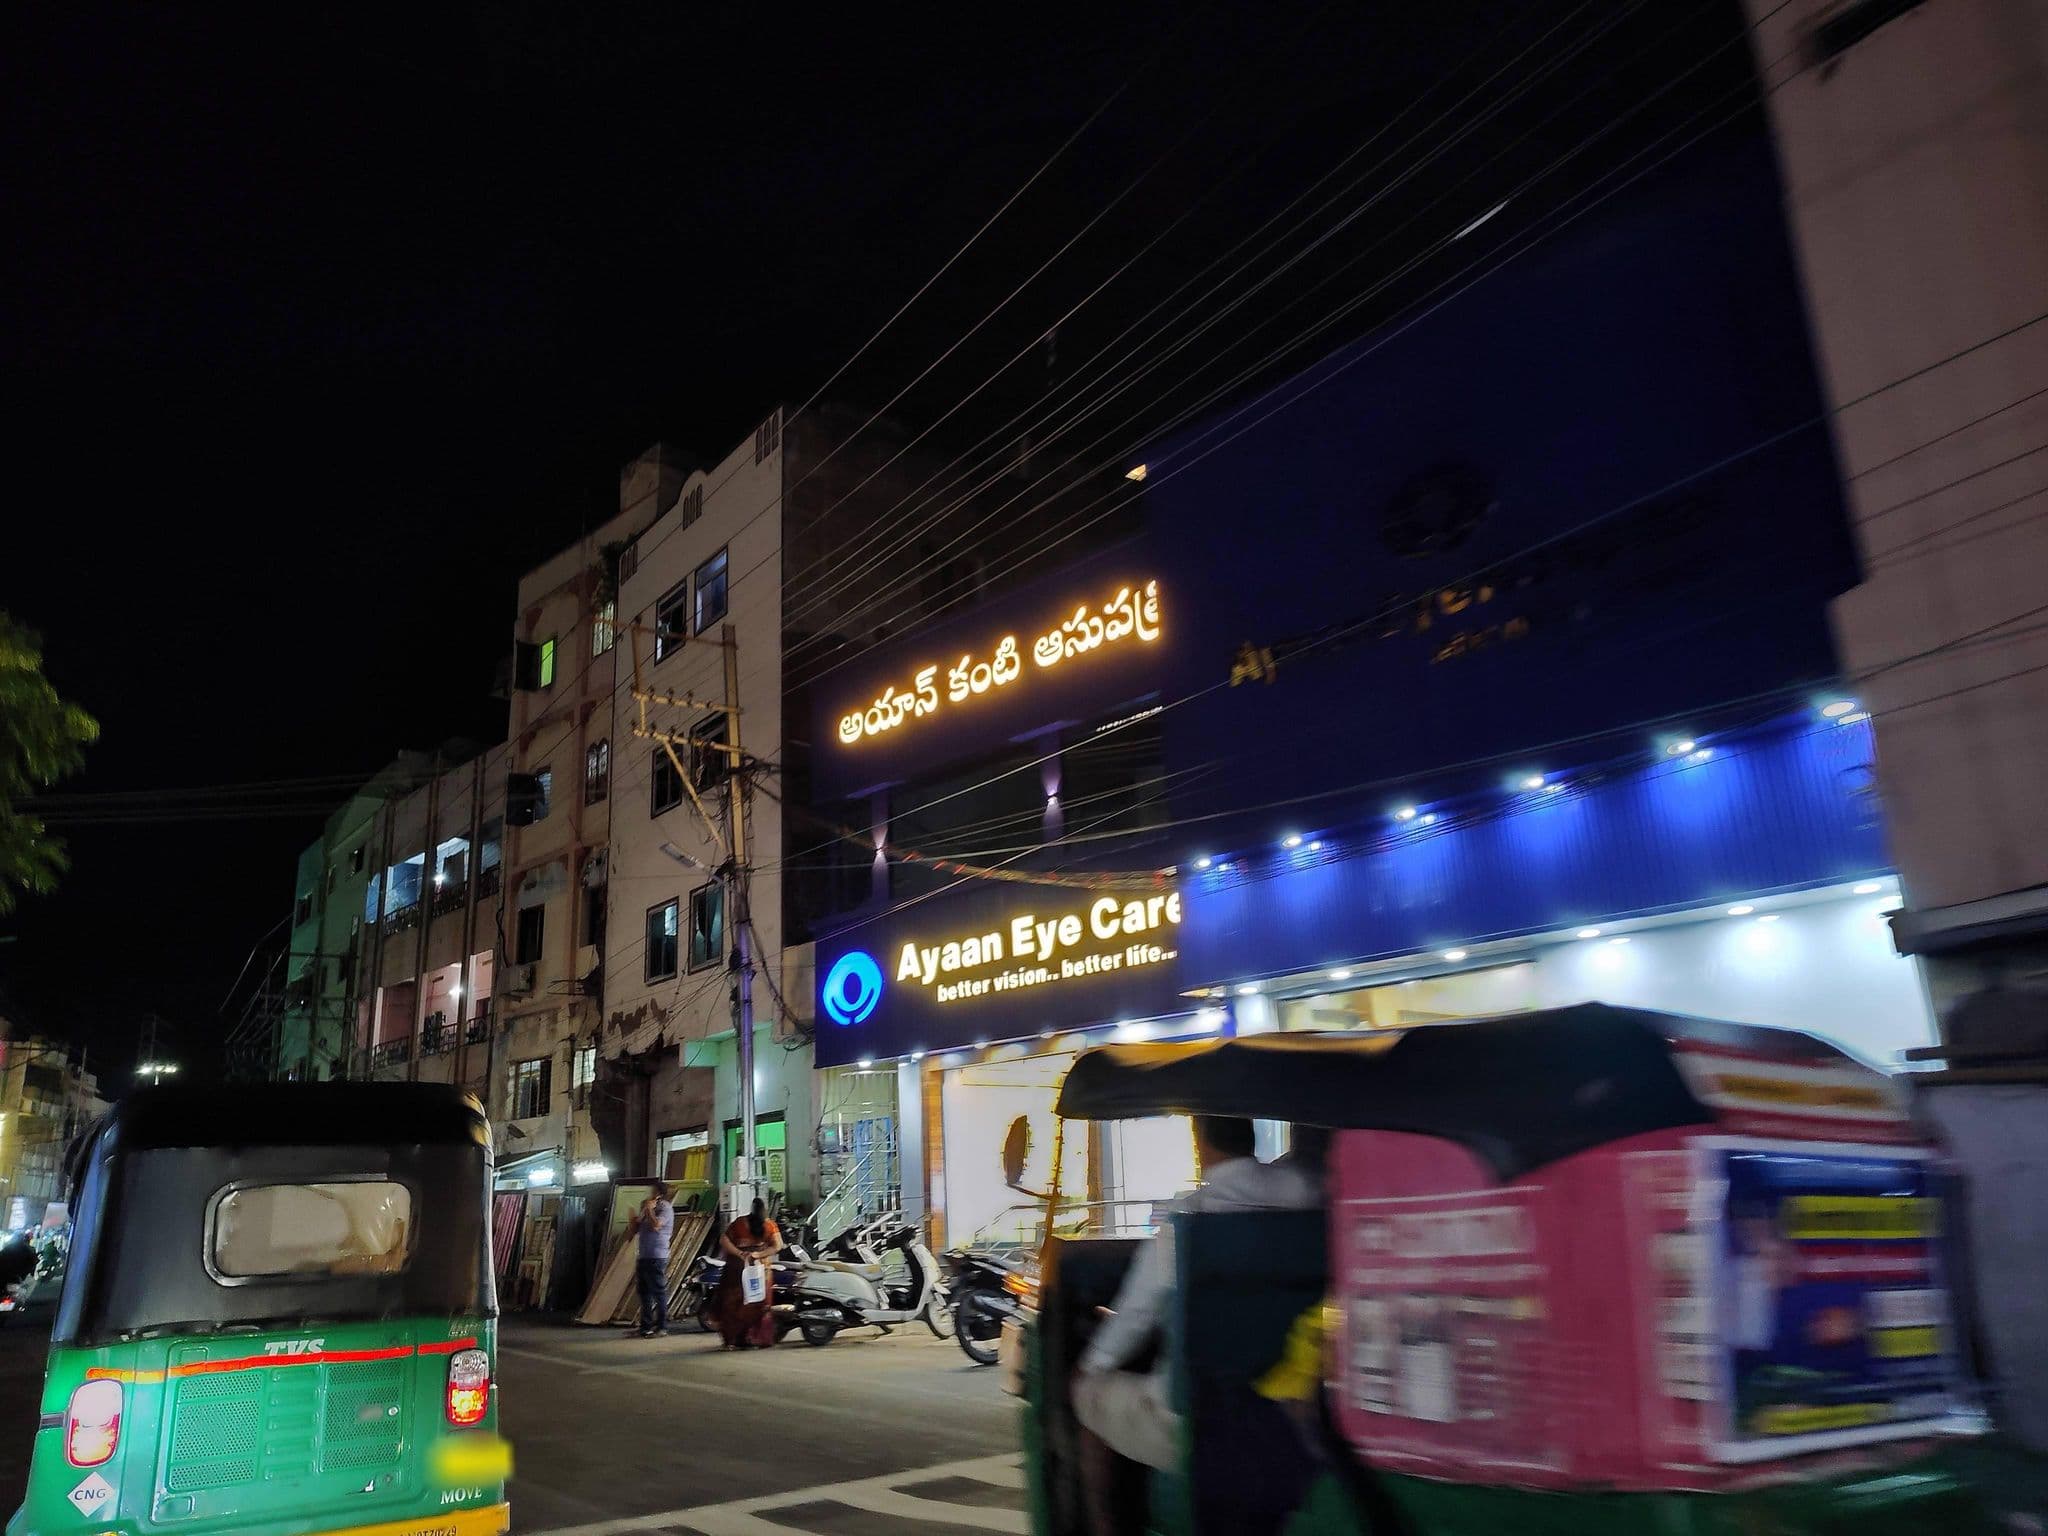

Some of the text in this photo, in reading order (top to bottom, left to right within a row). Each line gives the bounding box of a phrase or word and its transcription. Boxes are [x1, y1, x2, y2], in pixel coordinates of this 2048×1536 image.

[896, 892, 1181, 985] Ayaan Eye Care
[937, 978, 991, 1003] better
[1061, 952, 1123, 980] better
[264, 1338, 326, 1357] TVS
[74, 1488, 107, 1501] CNG
[440, 1485, 483, 1505] MOVE
